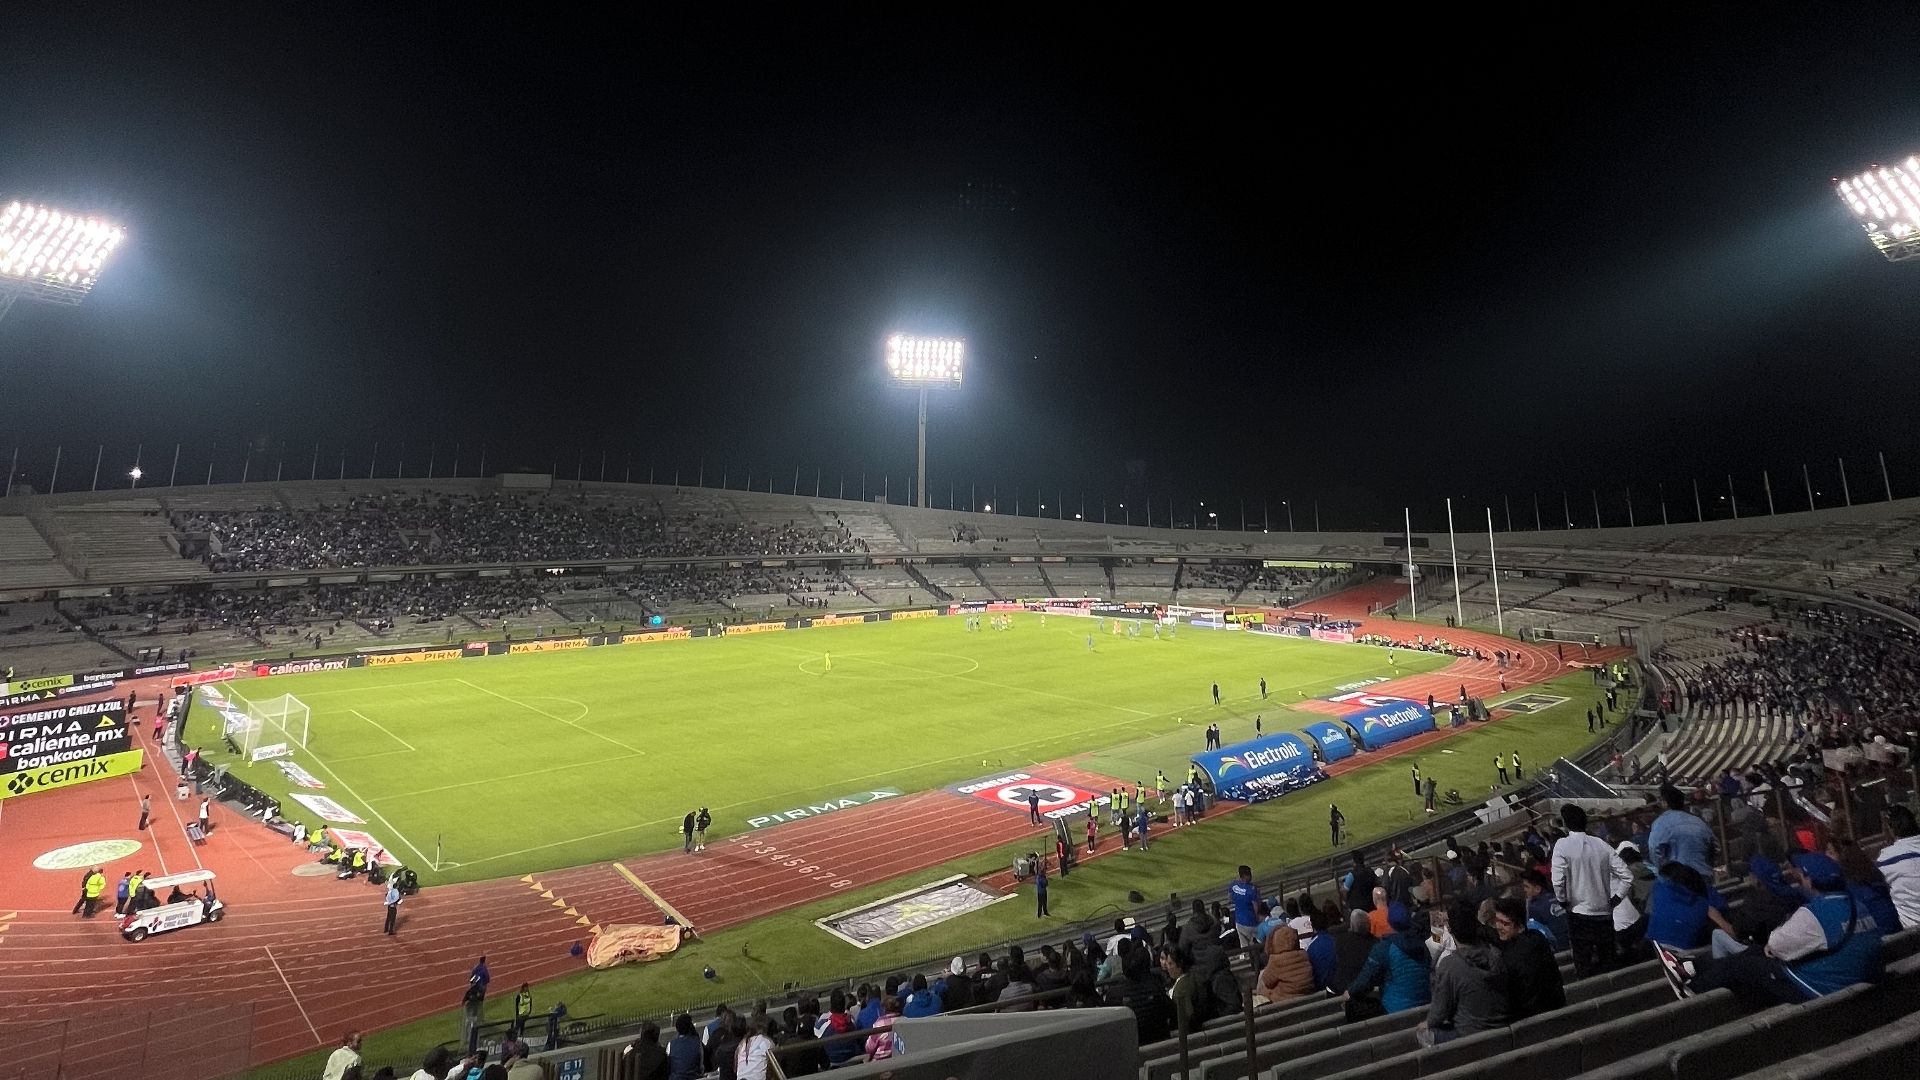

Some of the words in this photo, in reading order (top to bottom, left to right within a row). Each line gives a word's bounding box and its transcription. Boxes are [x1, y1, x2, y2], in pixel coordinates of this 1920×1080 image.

[553, 640, 588, 649] PIRMA
[269, 660, 345, 675] caliente.mx
[32, 677, 62, 689] cemix
[11, 709, 66, 725] CEMENTO
[68, 703, 96, 717] CRUZ
[96, 700, 122, 713] AZUL
[1380, 705, 1423, 728] Electrolit
[9, 728, 125, 757] caliente.mx
[1246, 741, 1302, 769] Electrolit
[17, 745, 97, 770] bankaool
[37, 759, 109, 786] cemix
[747, 798, 861, 828] PIRMA
